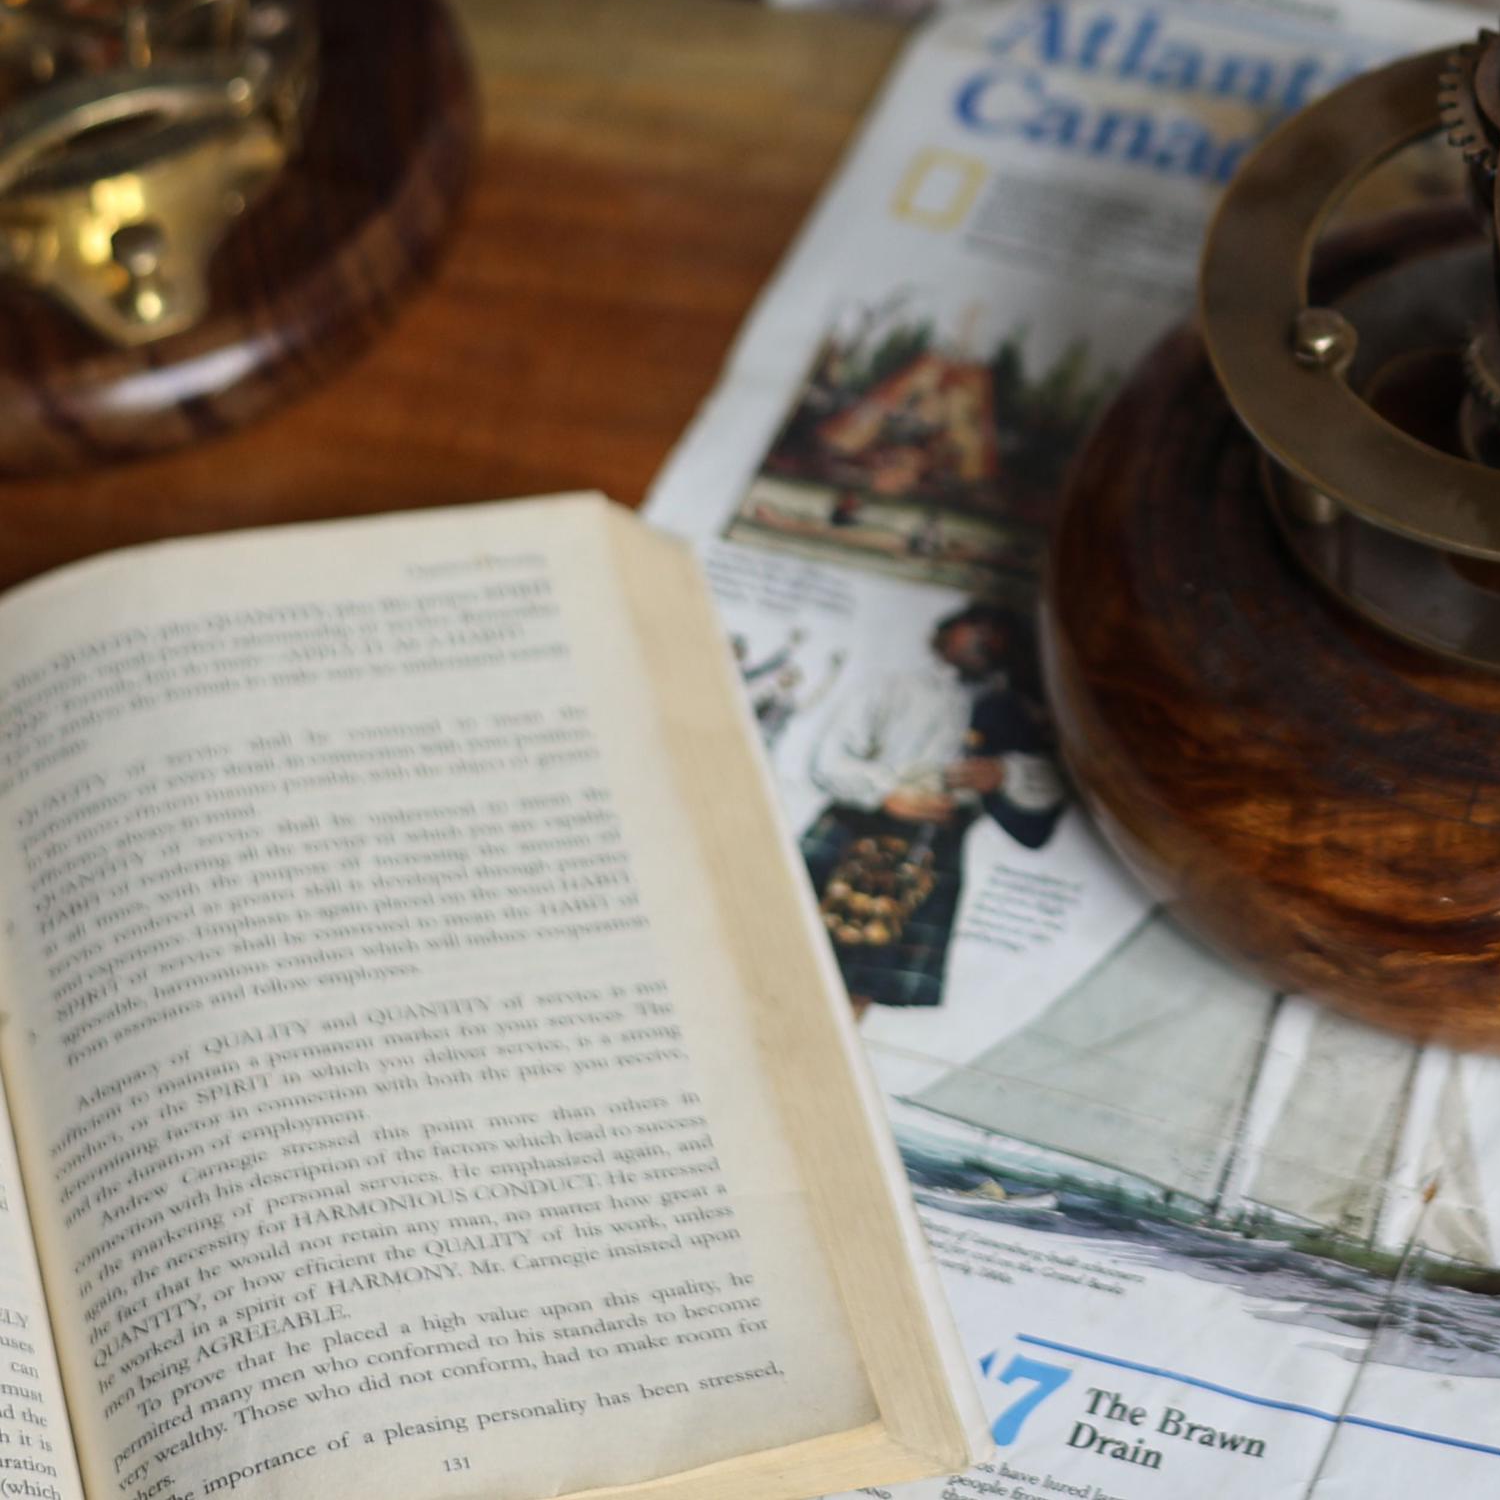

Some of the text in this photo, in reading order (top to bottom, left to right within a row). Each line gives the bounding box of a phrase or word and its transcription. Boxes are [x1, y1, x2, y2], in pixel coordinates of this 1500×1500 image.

[154, 1276, 190, 1301] that
[197, 1265, 220, 1282] he
[228, 1240, 290, 1269] would
[298, 1235, 332, 1252] not
[341, 1225, 398, 1243] retain
[405, 1220, 439, 1235] any
[504, 1210, 531, 1223] no
[538, 1201, 600, 1218] matter
[608, 1194, 649, 1210] how
[659, 1185, 708, 1207] great
[212, 1285, 233, 1302] or
[241, 1271, 284, 1291] how
[293, 1252, 375, 1277] efficient
[384, 1244, 415, 1261] the
[423, 1230, 528, 1258] QUALITY
[540, 1227, 562, 1242] of
[572, 1223, 602, 1238] his
[673, 1206, 733, 1224] unless
[191, 1321, 210, 1338] in
[235, 1295, 285, 1322] spirit
[293, 1286, 315, 1303] of
[511, 1250, 598, 1269] Carnegie
[607, 1233, 682, 1258] insisted
[689, 1228, 740, 1249] upon
[11, 1361, 40, 1379] can
[103, 1303, 350, 1418] men being AGREEABLE.
[136, 1397, 162, 1417] To
[171, 1368, 224, 1406] prove
[236, 1350, 274, 1372] that
[285, 1341, 310, 1356] he
[322, 1321, 388, 1353] placed
[420, 1311, 466, 1333] high
[476, 1306, 528, 1322] value
[540, 1300, 592, 1319] upon
[602, 1291, 639, 1307] this
[650, 1279, 720, 1303] quality,
[728, 1271, 752, 1287] he
[114, 1297, 760, 1472] permitted many men who conformed to his standards to become
[118, 1317, 767, 1490] very wealthy. Those who did not conform, had to make room for
[20, 1429, 53, 1452] it is
[22, 1407, 48, 1428] the
[204, 1445, 315, 1493] importance
[326, 1434, 348, 1451] of
[383, 1417, 468, 1445] pleasing
[476, 1398, 585, 1430] personality
[595, 1392, 631, 1407] has
[638, 1382, 689, 1399] been
[698, 1360, 784, 1389] stressed,
[1066, 1419, 1164, 1471] Drain
[1086, 1386, 1268, 1459] The Brawn
[0, 1456, 57, 1478] ration
[1, 1478, 62, 1500] (which
[441, 1457, 471, 1471] 131
[947, 1474, 1008, 1494] people
[999, 1462, 1040, 1486] have
[1043, 1475, 1091, 1499] lured
